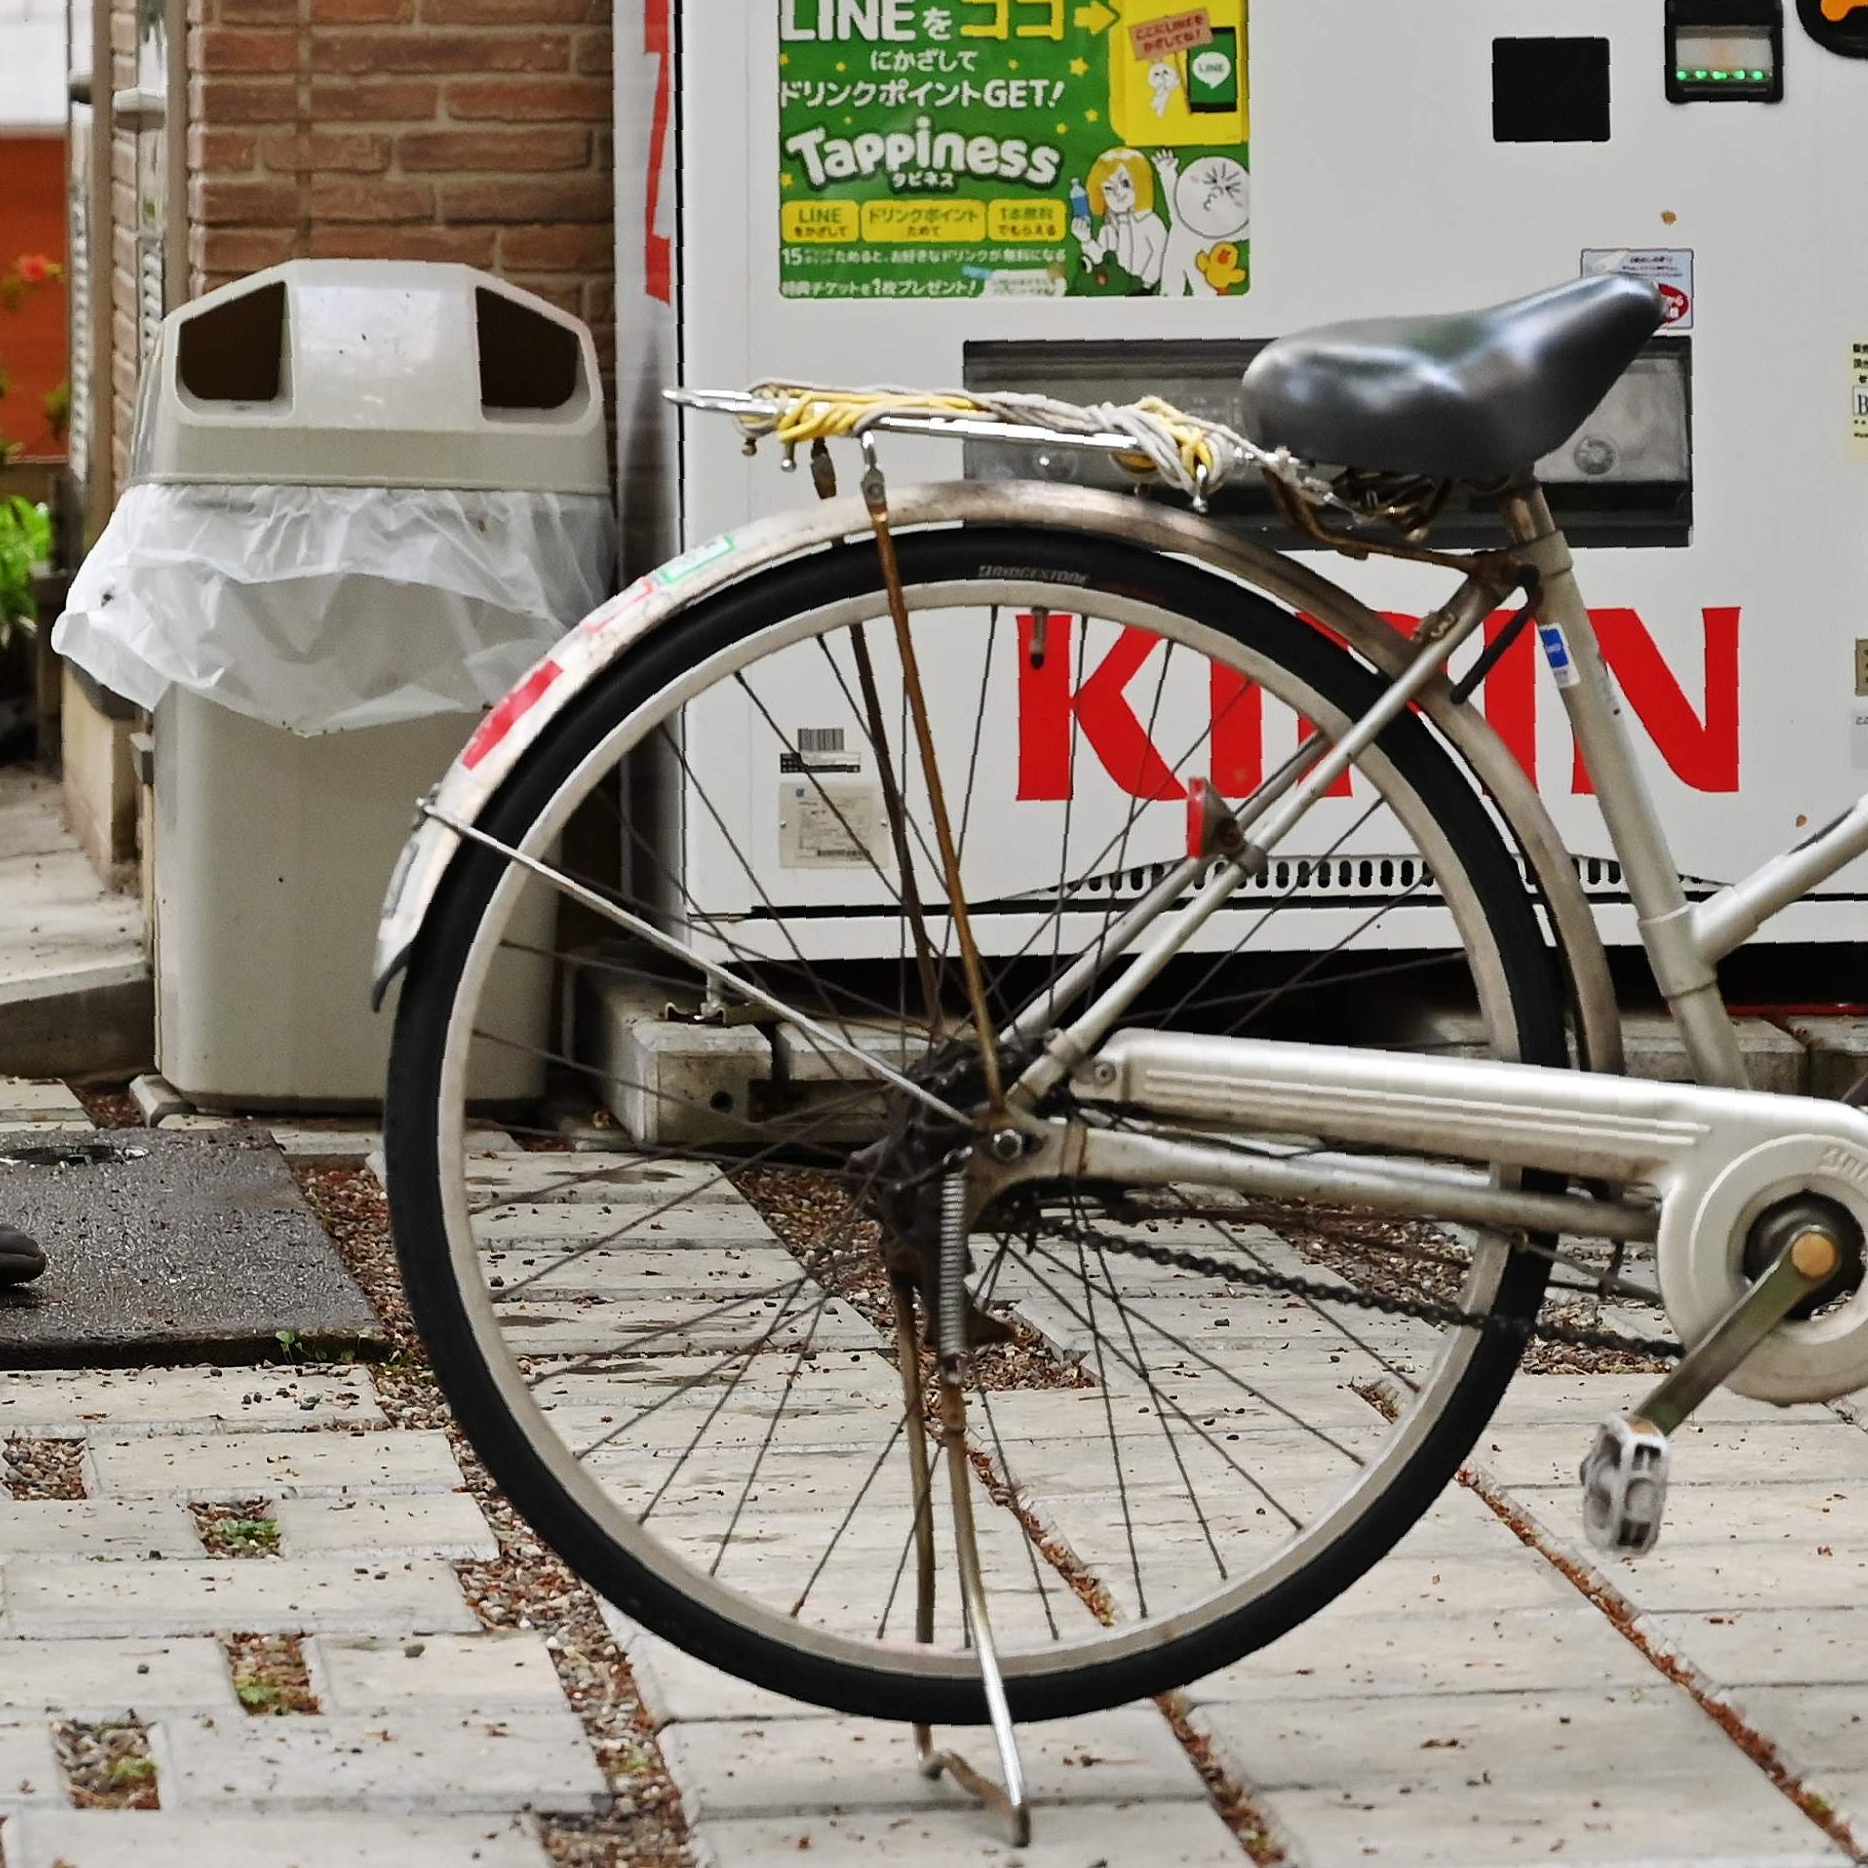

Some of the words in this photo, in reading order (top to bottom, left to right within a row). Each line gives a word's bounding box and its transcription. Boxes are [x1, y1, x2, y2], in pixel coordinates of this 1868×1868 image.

[870, 49, 979, 73] にかざして
[780, 78, 1065, 109] ドリンクポイントGET!
[786, 116, 1061, 187] Tappiness
[798, 207, 843, 224] LINE
[869, 208, 979, 225] ドリンクポイント
[1017, 606, 1741, 803] KIIN
